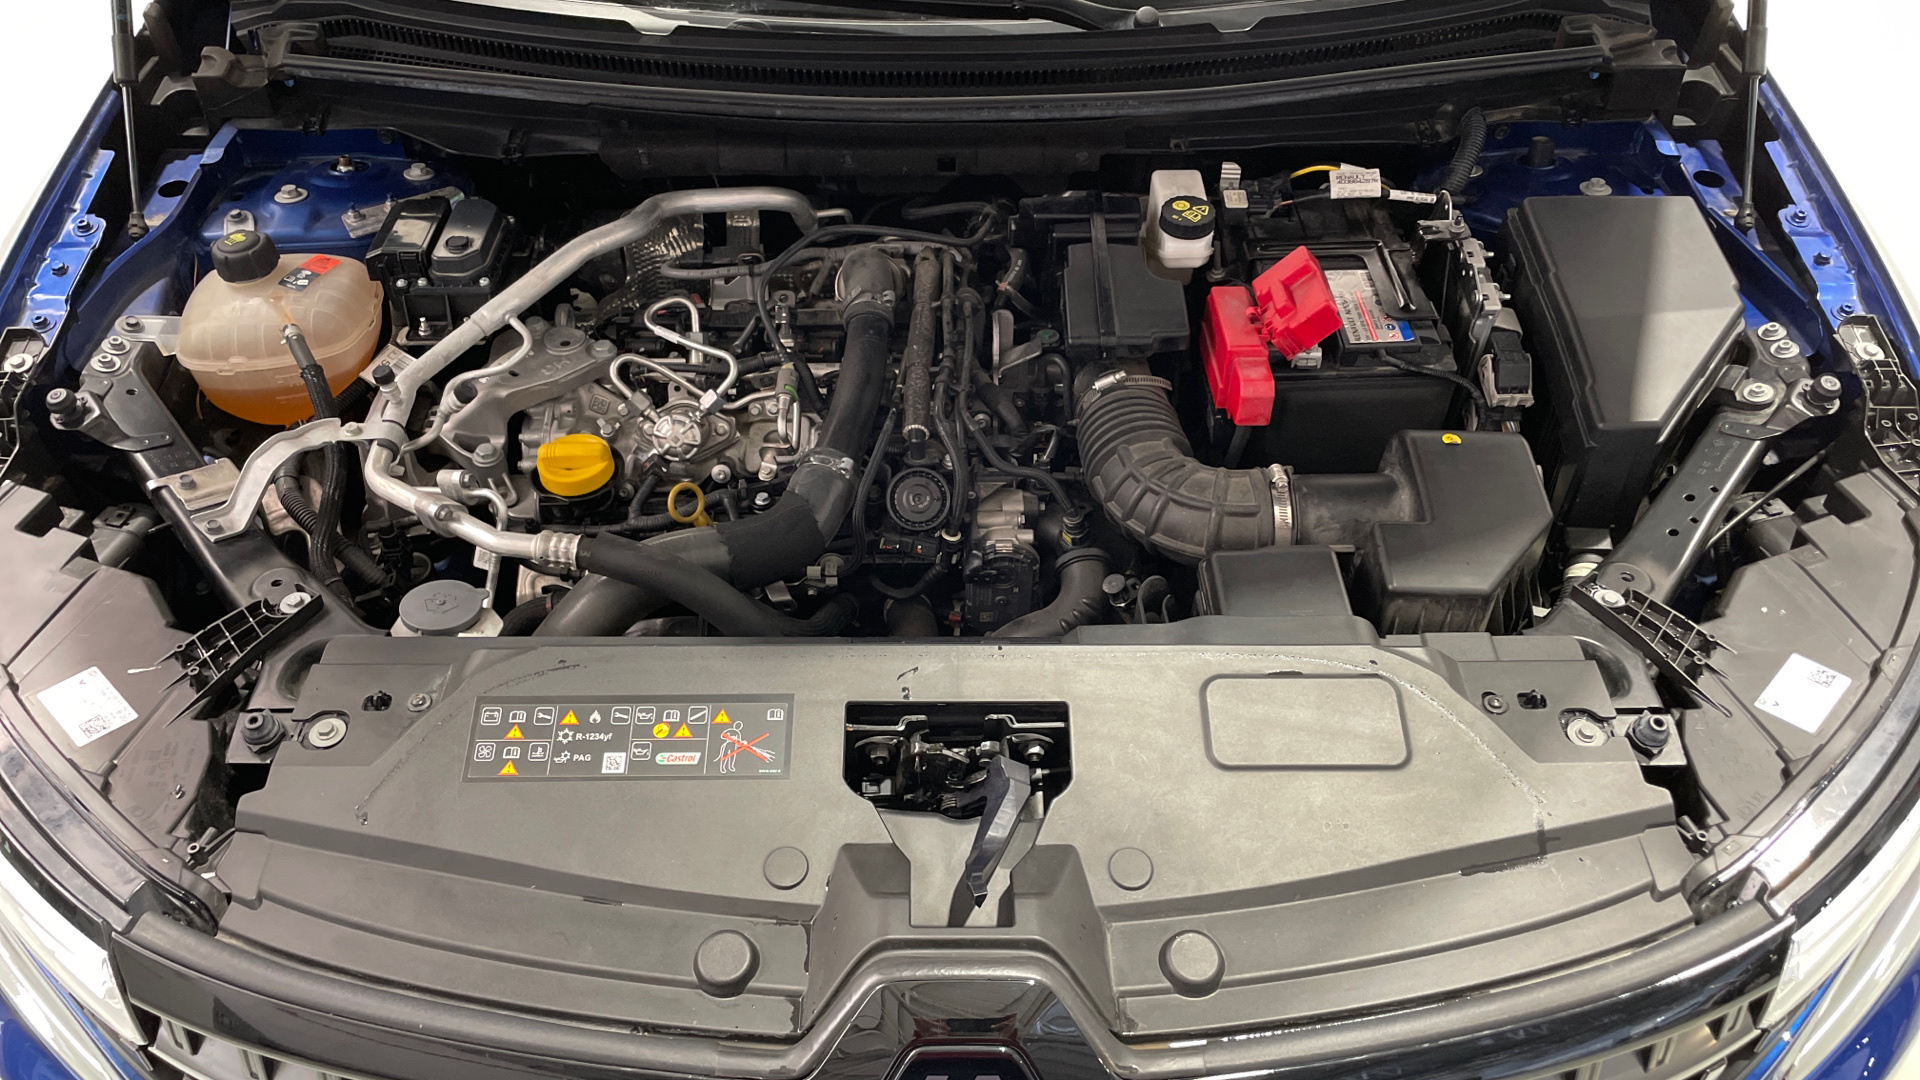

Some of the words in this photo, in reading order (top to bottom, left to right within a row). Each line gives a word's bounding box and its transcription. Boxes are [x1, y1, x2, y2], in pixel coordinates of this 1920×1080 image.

[1347, 317, 1361, 341] RENAULT
[575, 732, 613, 741] R-1234yf
[573, 754, 592, 762] PAG
[666, 753, 697, 763] Castrol
